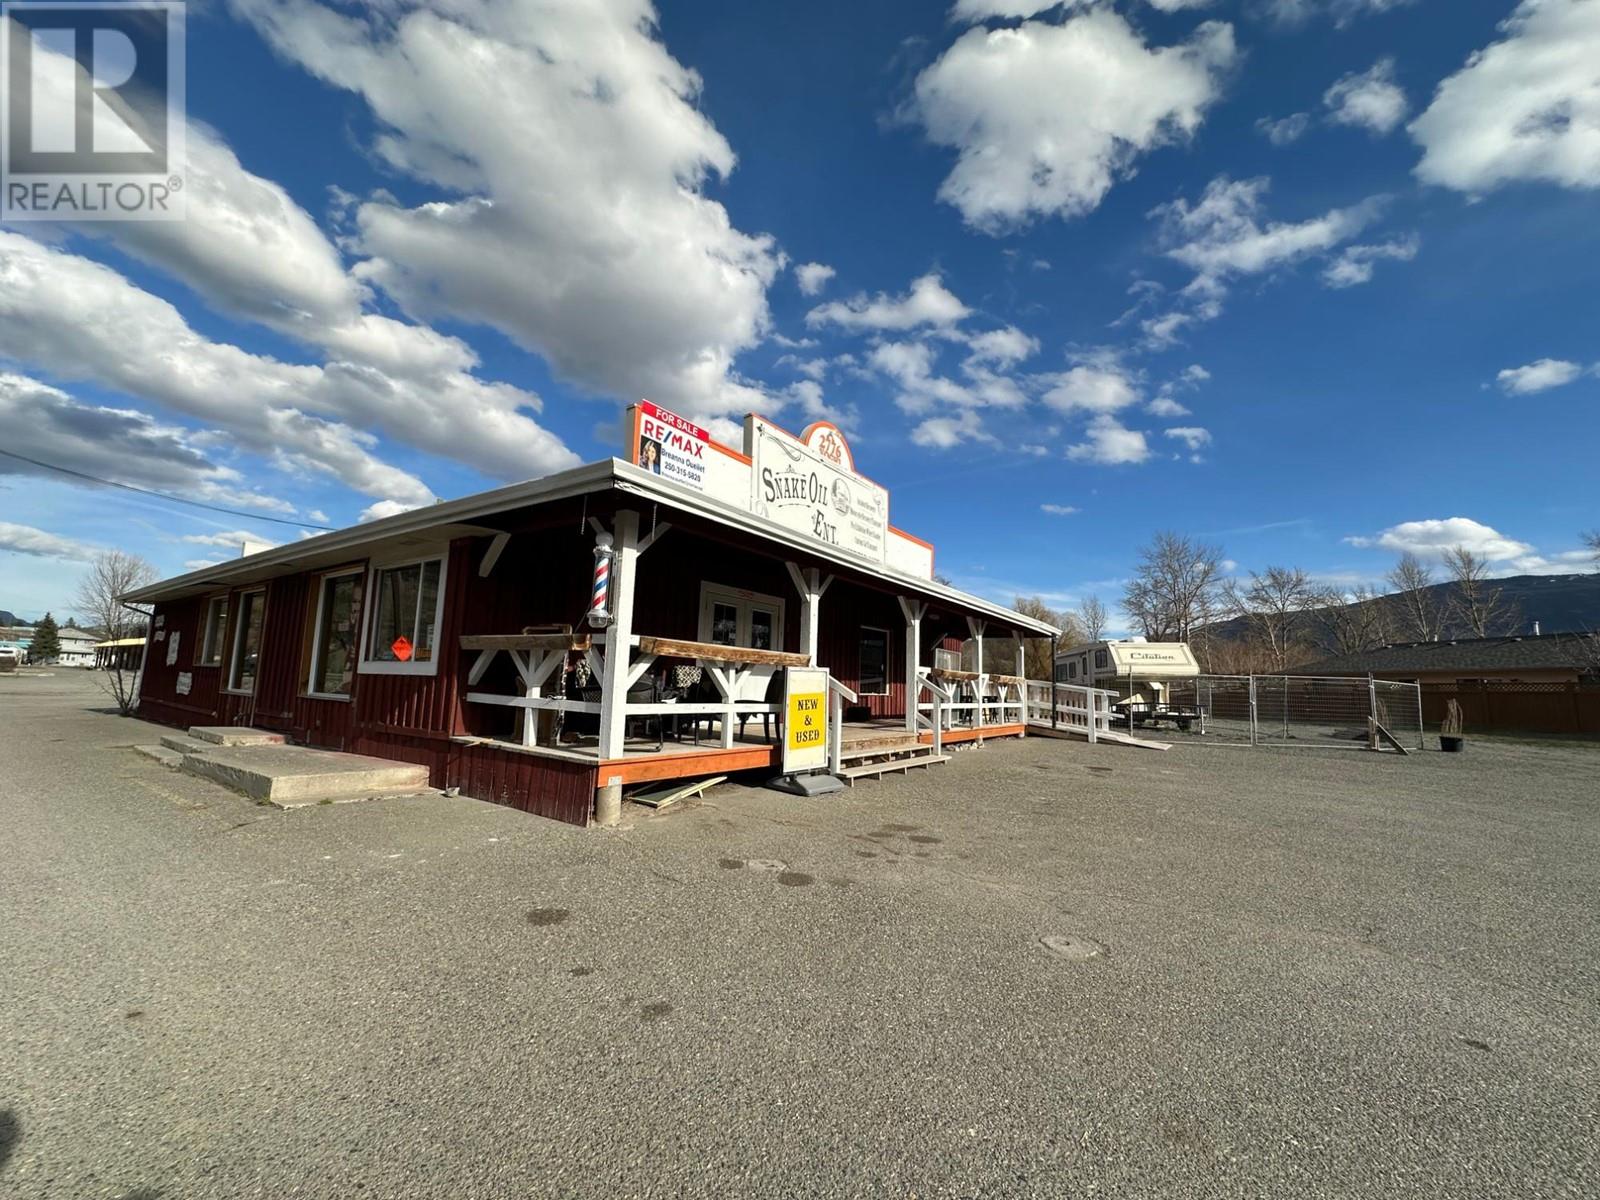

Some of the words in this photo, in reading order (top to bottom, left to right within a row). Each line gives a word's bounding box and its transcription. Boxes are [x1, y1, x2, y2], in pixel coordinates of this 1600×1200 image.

[655, 408, 675, 425] FOR
[676, 419, 699, 437] SALE
[644, 419, 704, 460] RE/MAX
[762, 467, 807, 503] SNAKE
[808, 472, 828, 506] OIL
[797, 698, 819, 711] NEW
[804, 715, 812, 726] &
[796, 729, 820, 744] USED
